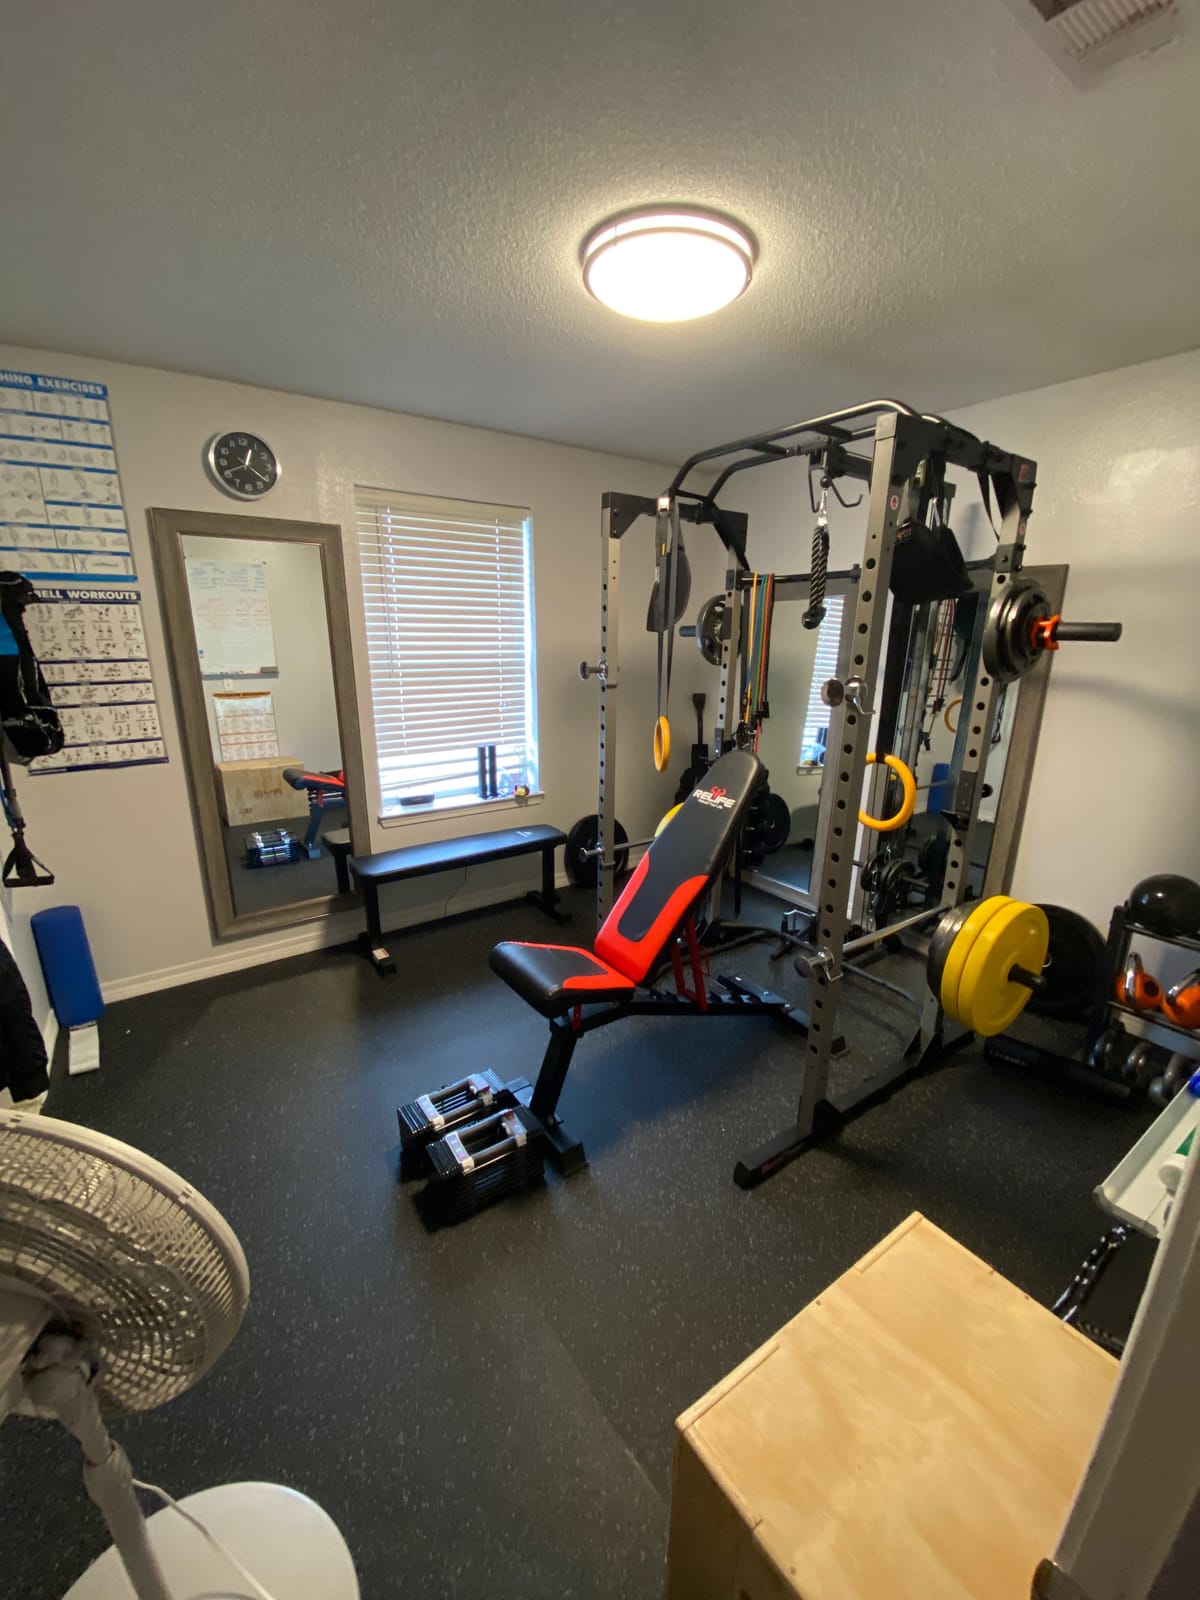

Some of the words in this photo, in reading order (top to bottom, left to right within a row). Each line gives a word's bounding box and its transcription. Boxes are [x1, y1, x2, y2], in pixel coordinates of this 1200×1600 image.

[0, 372, 33, 385] HING
[37, 377, 104, 394] EXERCISES
[238, 437, 248, 446] 12
[220, 447, 229, 455] 10
[260, 452, 268, 460] 2
[234, 478, 241, 488] 7
[245, 483, 253, 492] 6
[67, 590, 137, 600] WORKOUTS
[693, 789, 736, 808] RELIFE
